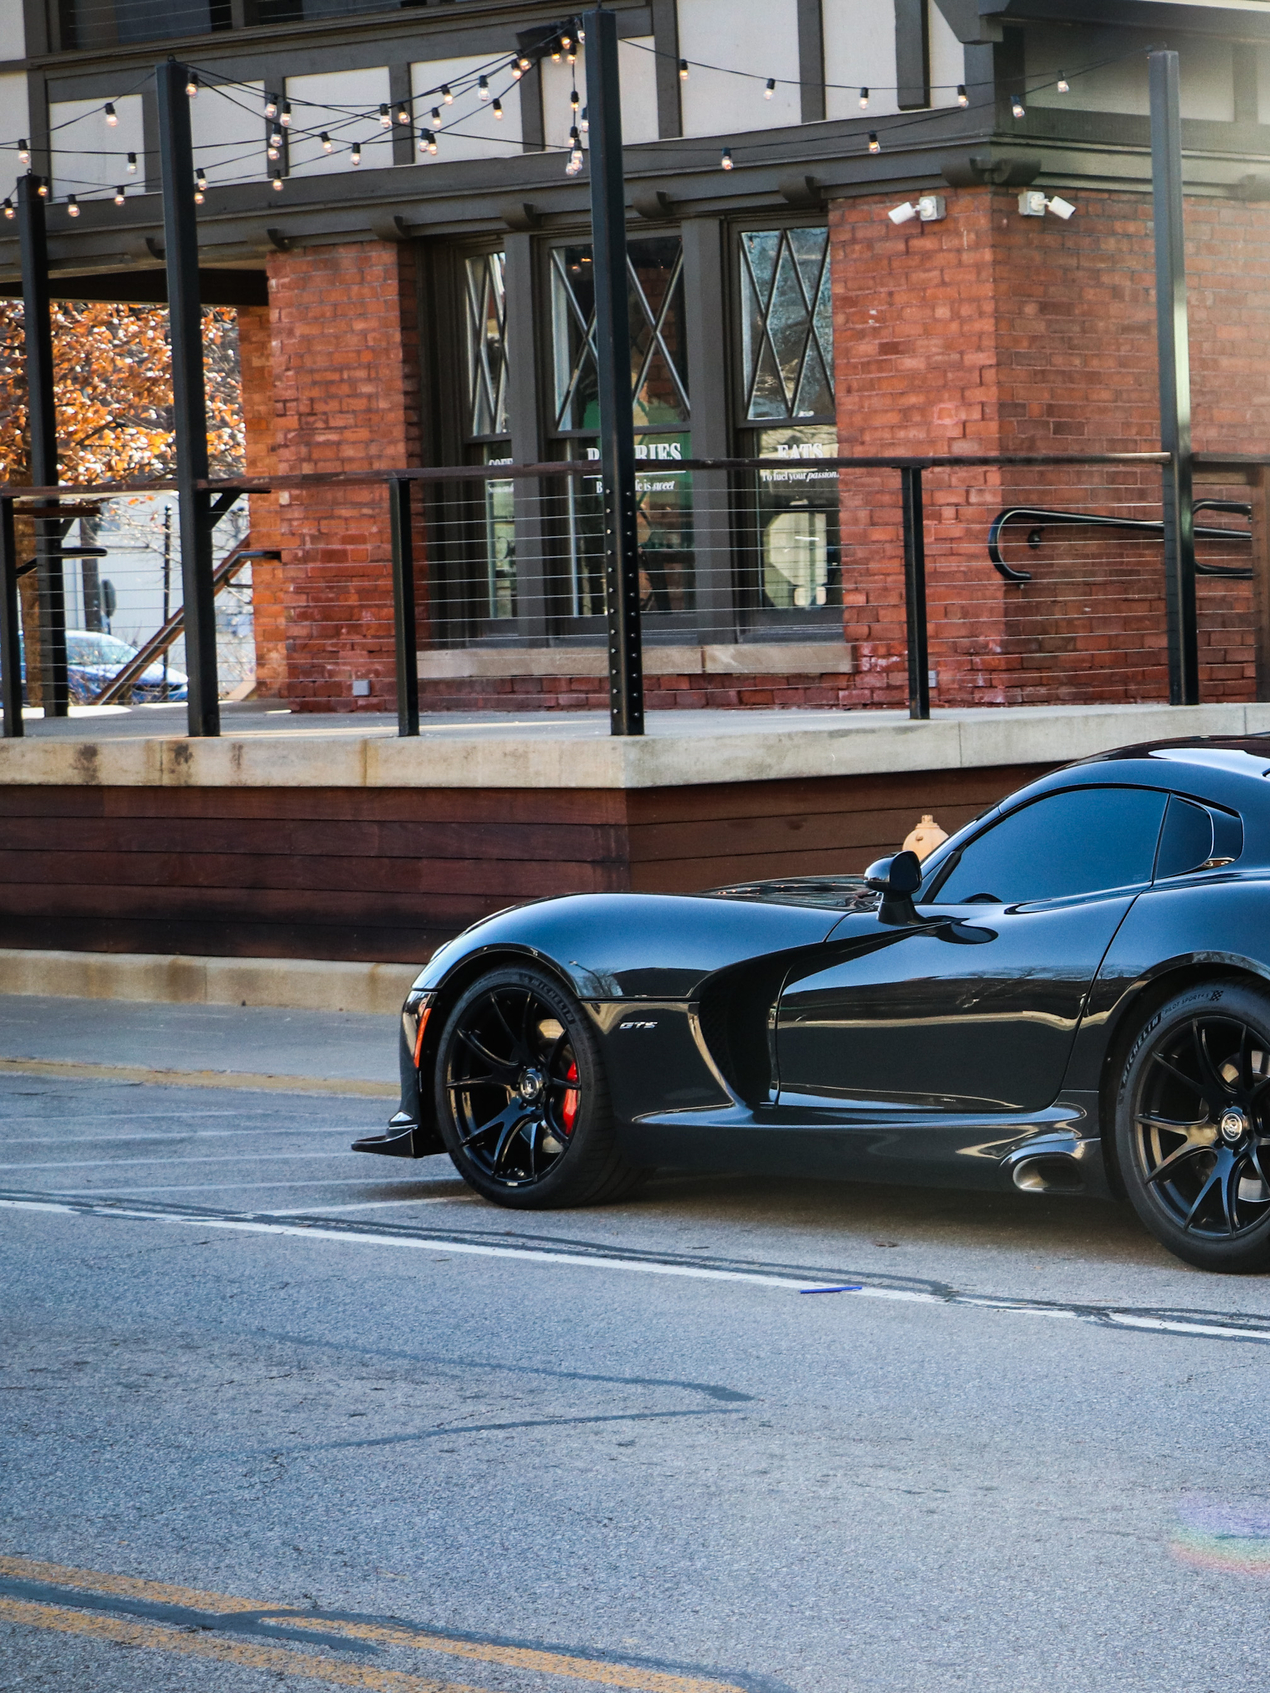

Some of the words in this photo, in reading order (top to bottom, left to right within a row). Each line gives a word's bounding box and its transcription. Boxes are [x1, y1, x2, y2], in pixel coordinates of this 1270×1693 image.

[776, 443, 824, 459] EATS
[773, 470, 788, 481] fuel
[788, 471, 807, 483] your
[619, 1021, 659, 1030] GTS
[1121, 1014, 1161, 1085] MICHELIN
